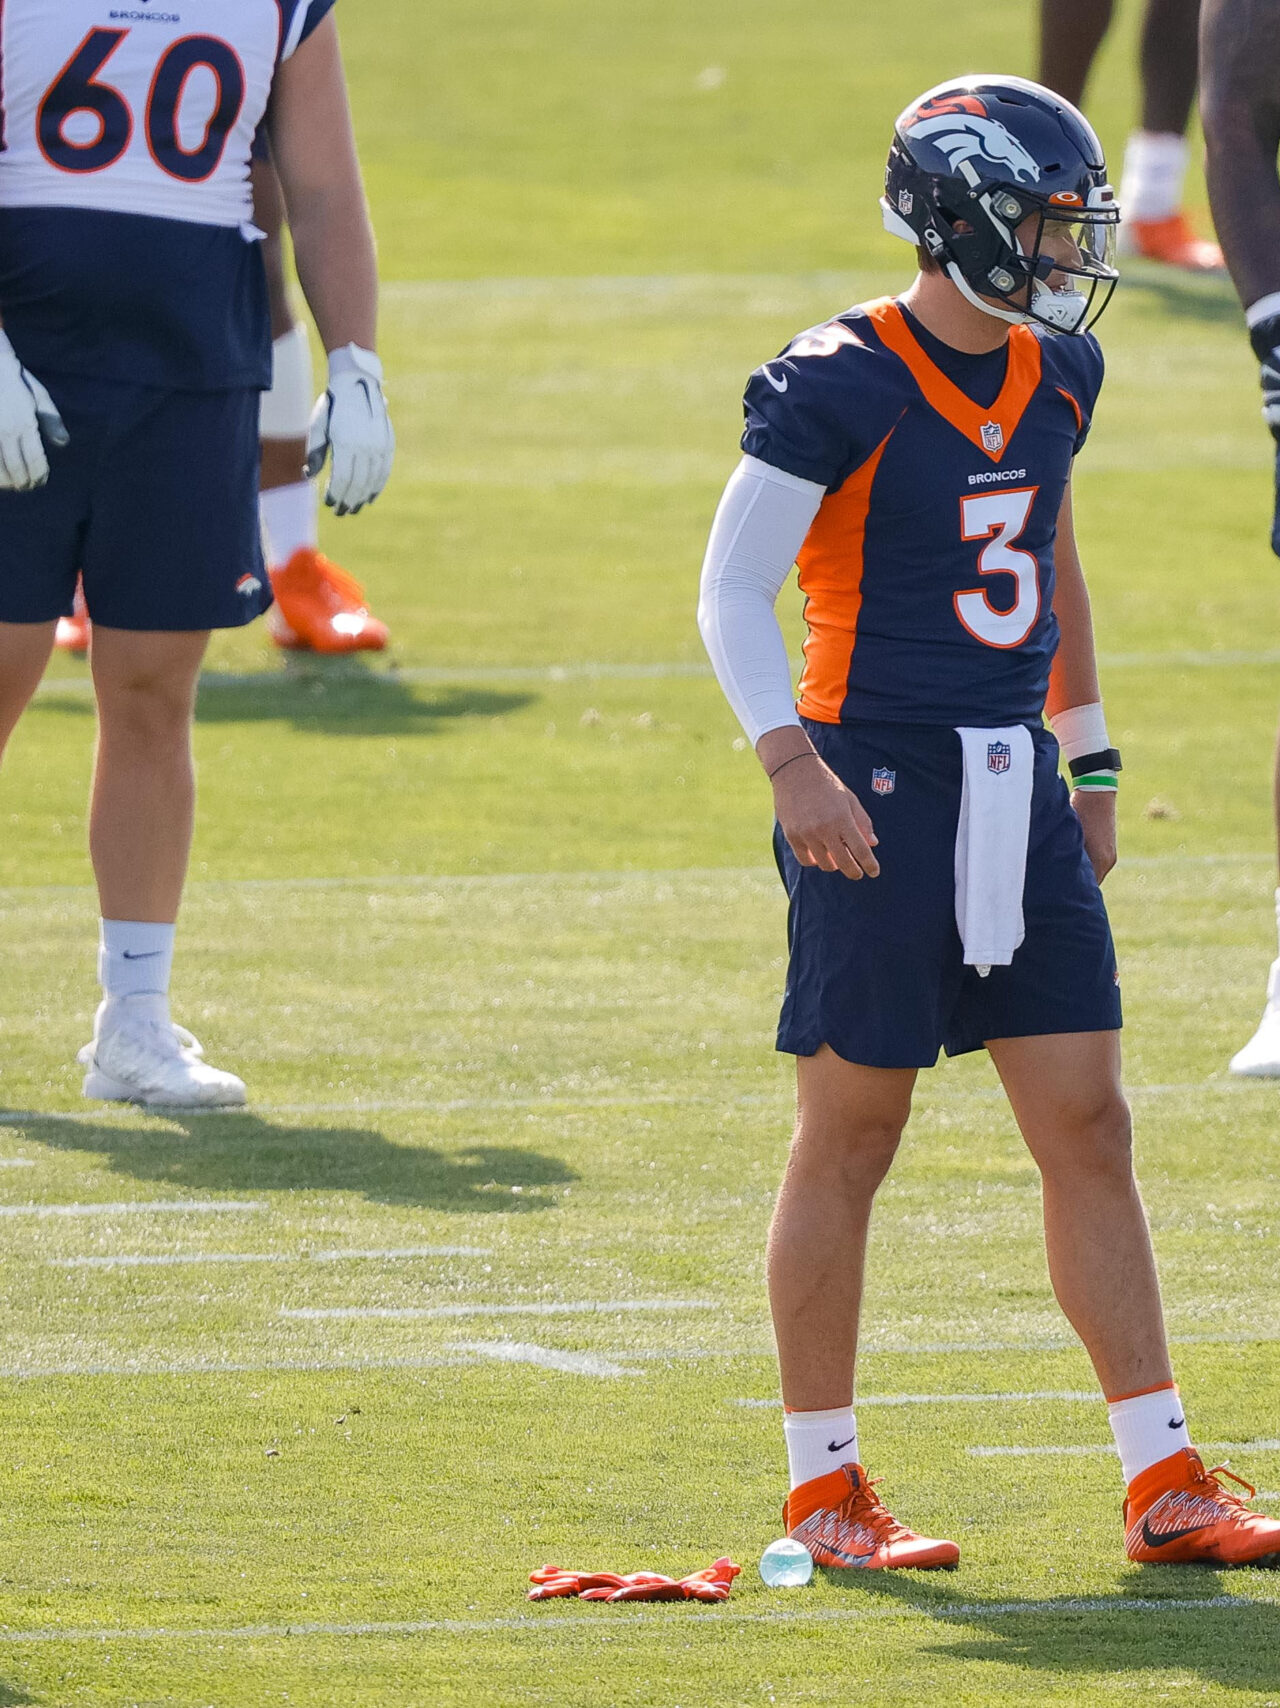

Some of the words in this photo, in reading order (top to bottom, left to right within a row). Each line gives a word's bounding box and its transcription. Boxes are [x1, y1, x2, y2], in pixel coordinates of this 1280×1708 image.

[36, 25, 246, 183] 60
[967, 468, 1027, 486] BRONCOS
[953, 485, 1040, 649] 3
[989, 755, 1009, 770] NFL
[874, 779, 891, 791] NFL
